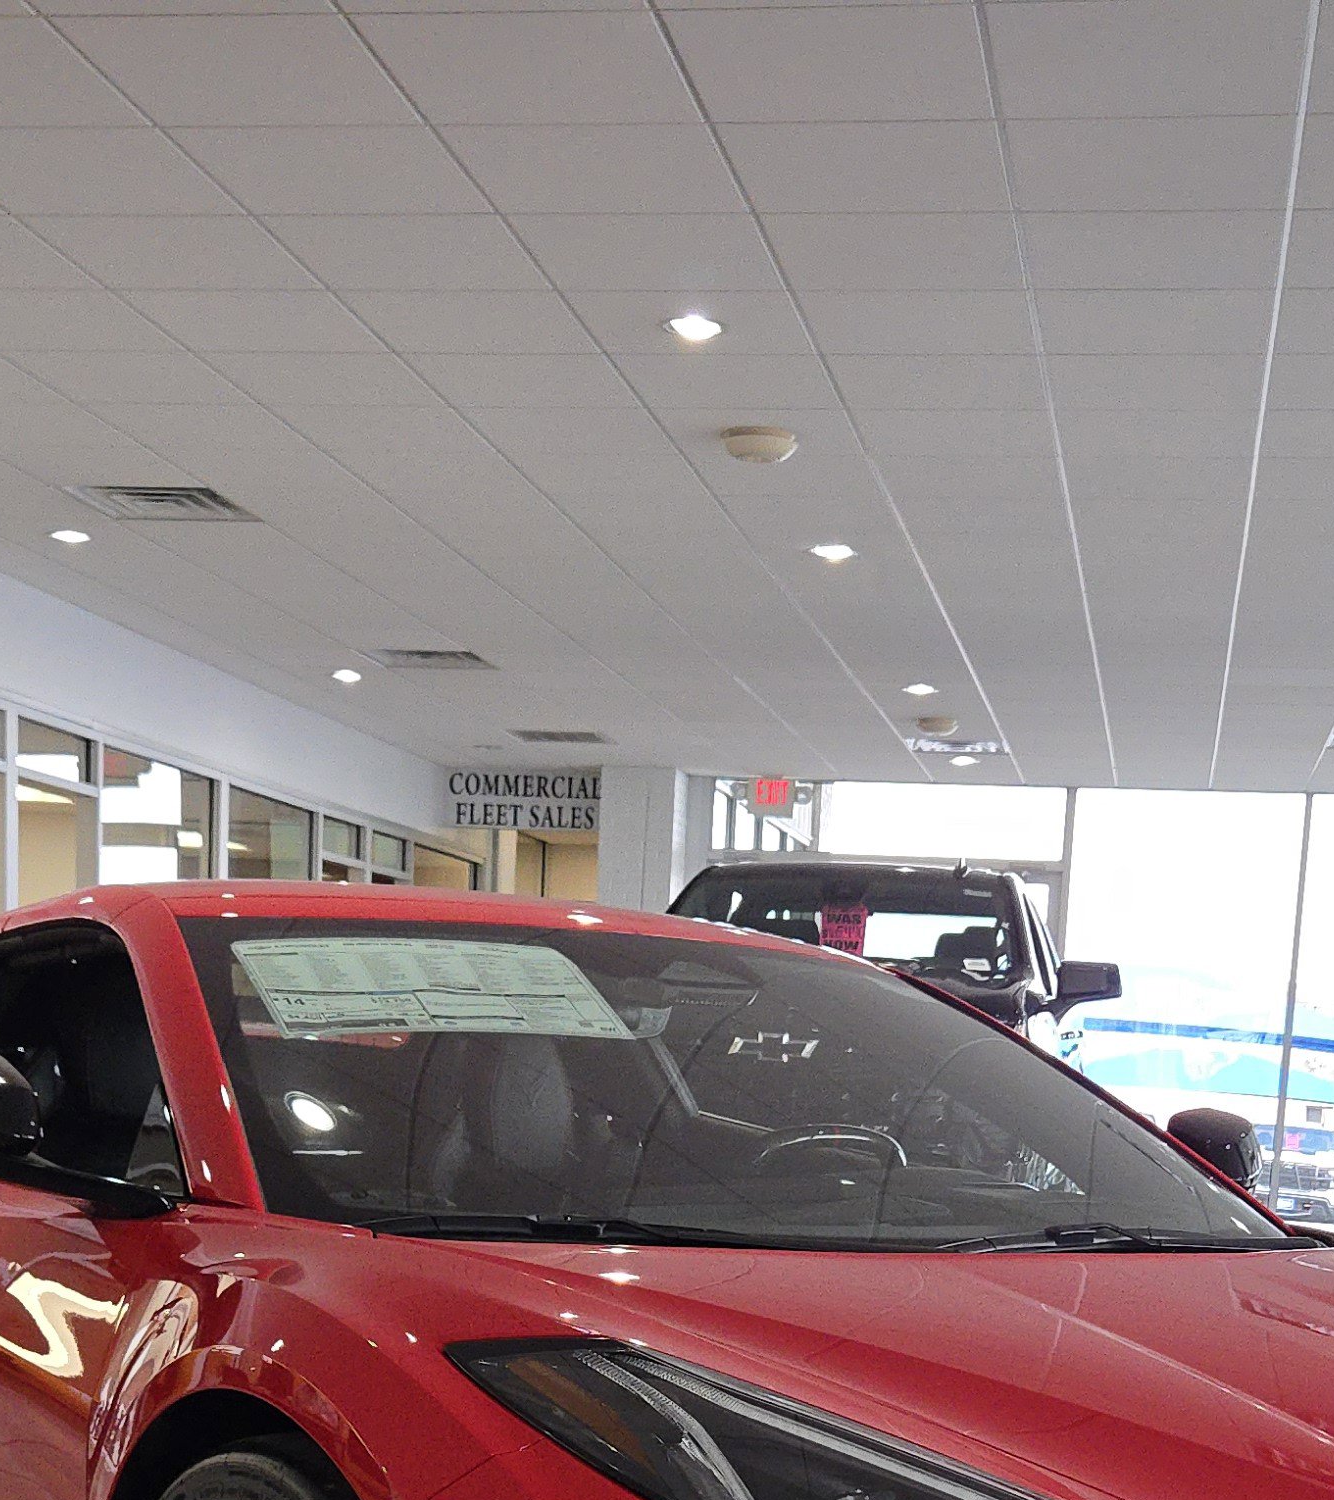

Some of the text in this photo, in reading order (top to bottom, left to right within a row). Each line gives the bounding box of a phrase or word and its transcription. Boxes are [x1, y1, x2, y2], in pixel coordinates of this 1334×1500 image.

[755, 778, 790, 805] EXIT
[456, 802, 595, 829] FLEET SALES
[827, 913, 862, 924] WAS
